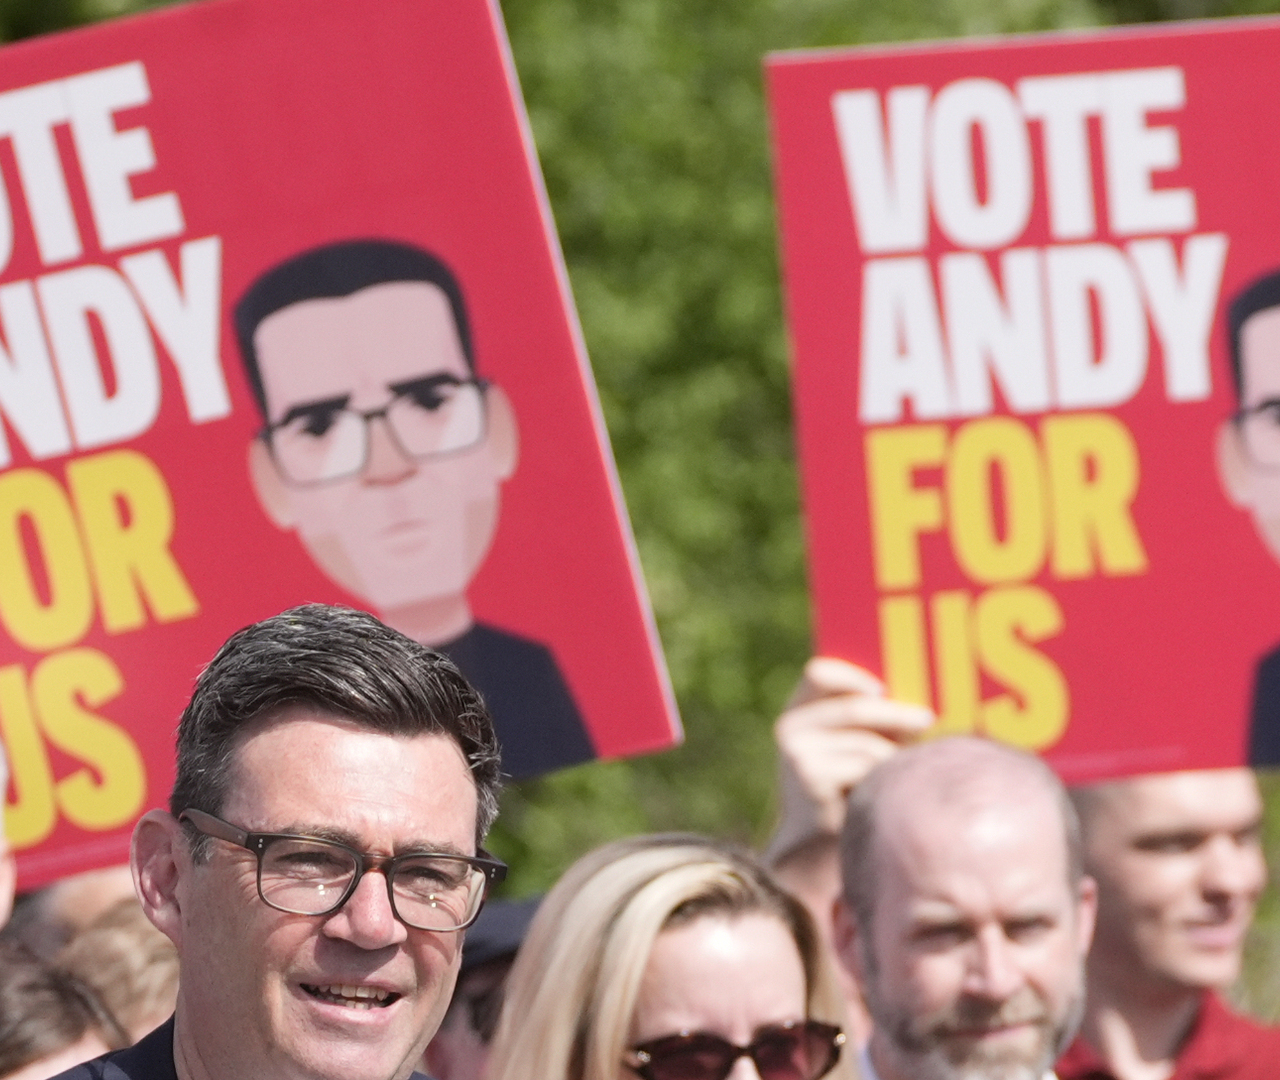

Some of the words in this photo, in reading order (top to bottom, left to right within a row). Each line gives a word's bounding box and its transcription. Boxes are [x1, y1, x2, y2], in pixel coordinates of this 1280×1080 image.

[832, 67, 1197, 254] VOTE
[858, 233, 1228, 423] ANDY
[864, 414, 1148, 591] FOR
[878, 584, 1070, 751] US
